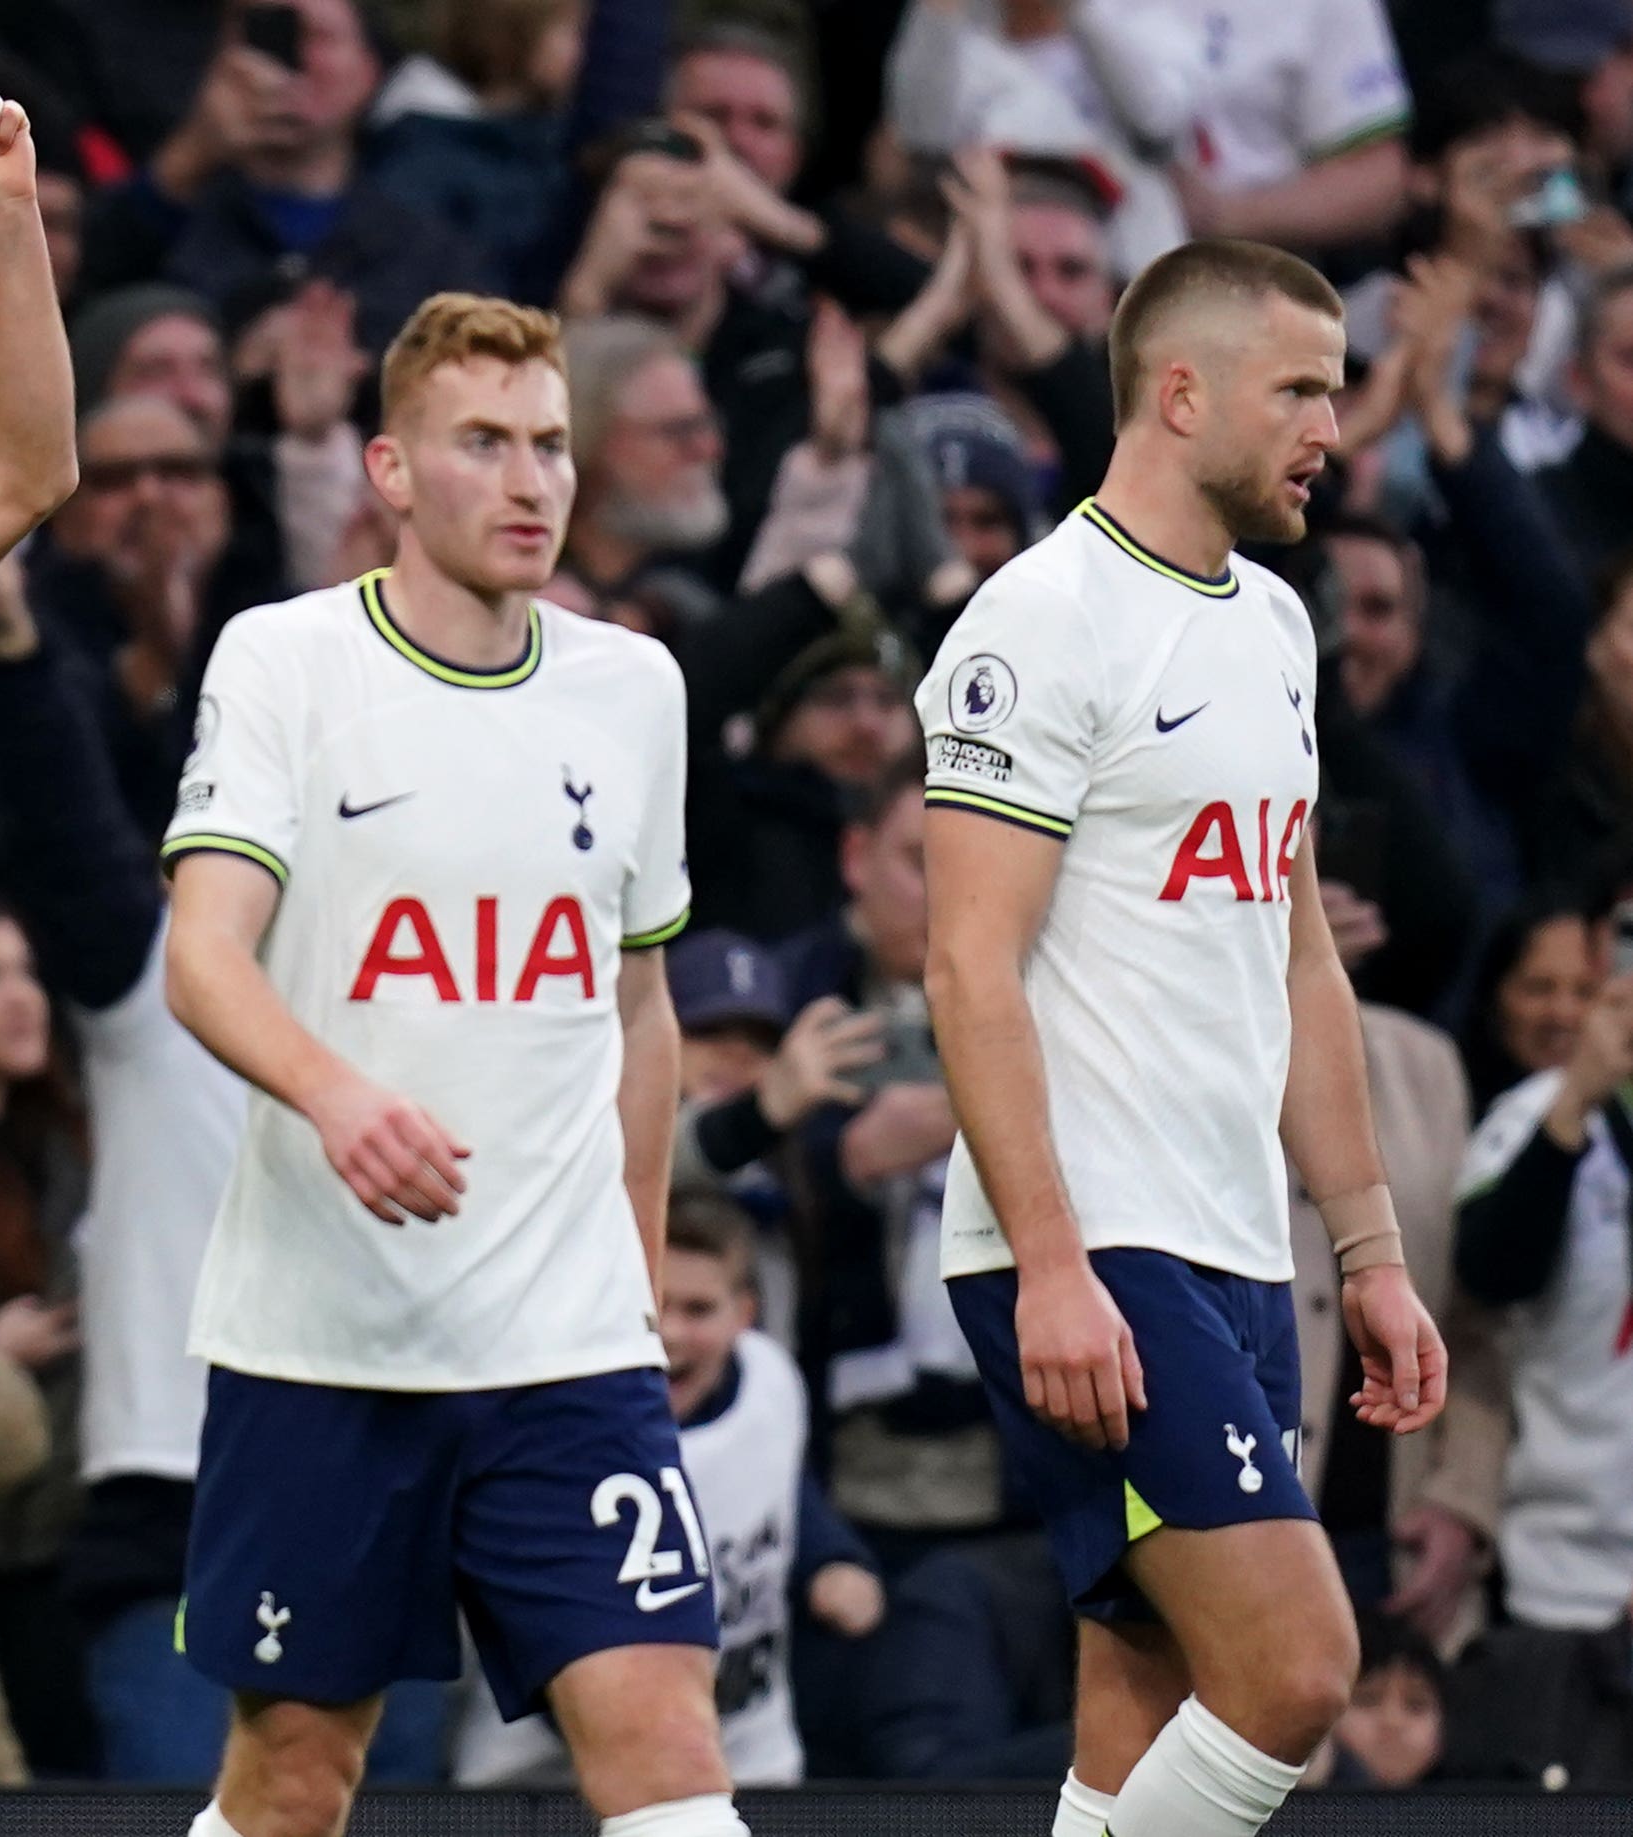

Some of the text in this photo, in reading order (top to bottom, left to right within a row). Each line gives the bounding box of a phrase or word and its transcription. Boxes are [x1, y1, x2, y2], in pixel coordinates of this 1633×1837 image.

[959, 744, 1006, 766] room
[1157, 798, 1307, 902] AIA
[348, 895, 595, 1002] AIA
[590, 1466, 710, 1584] 21
